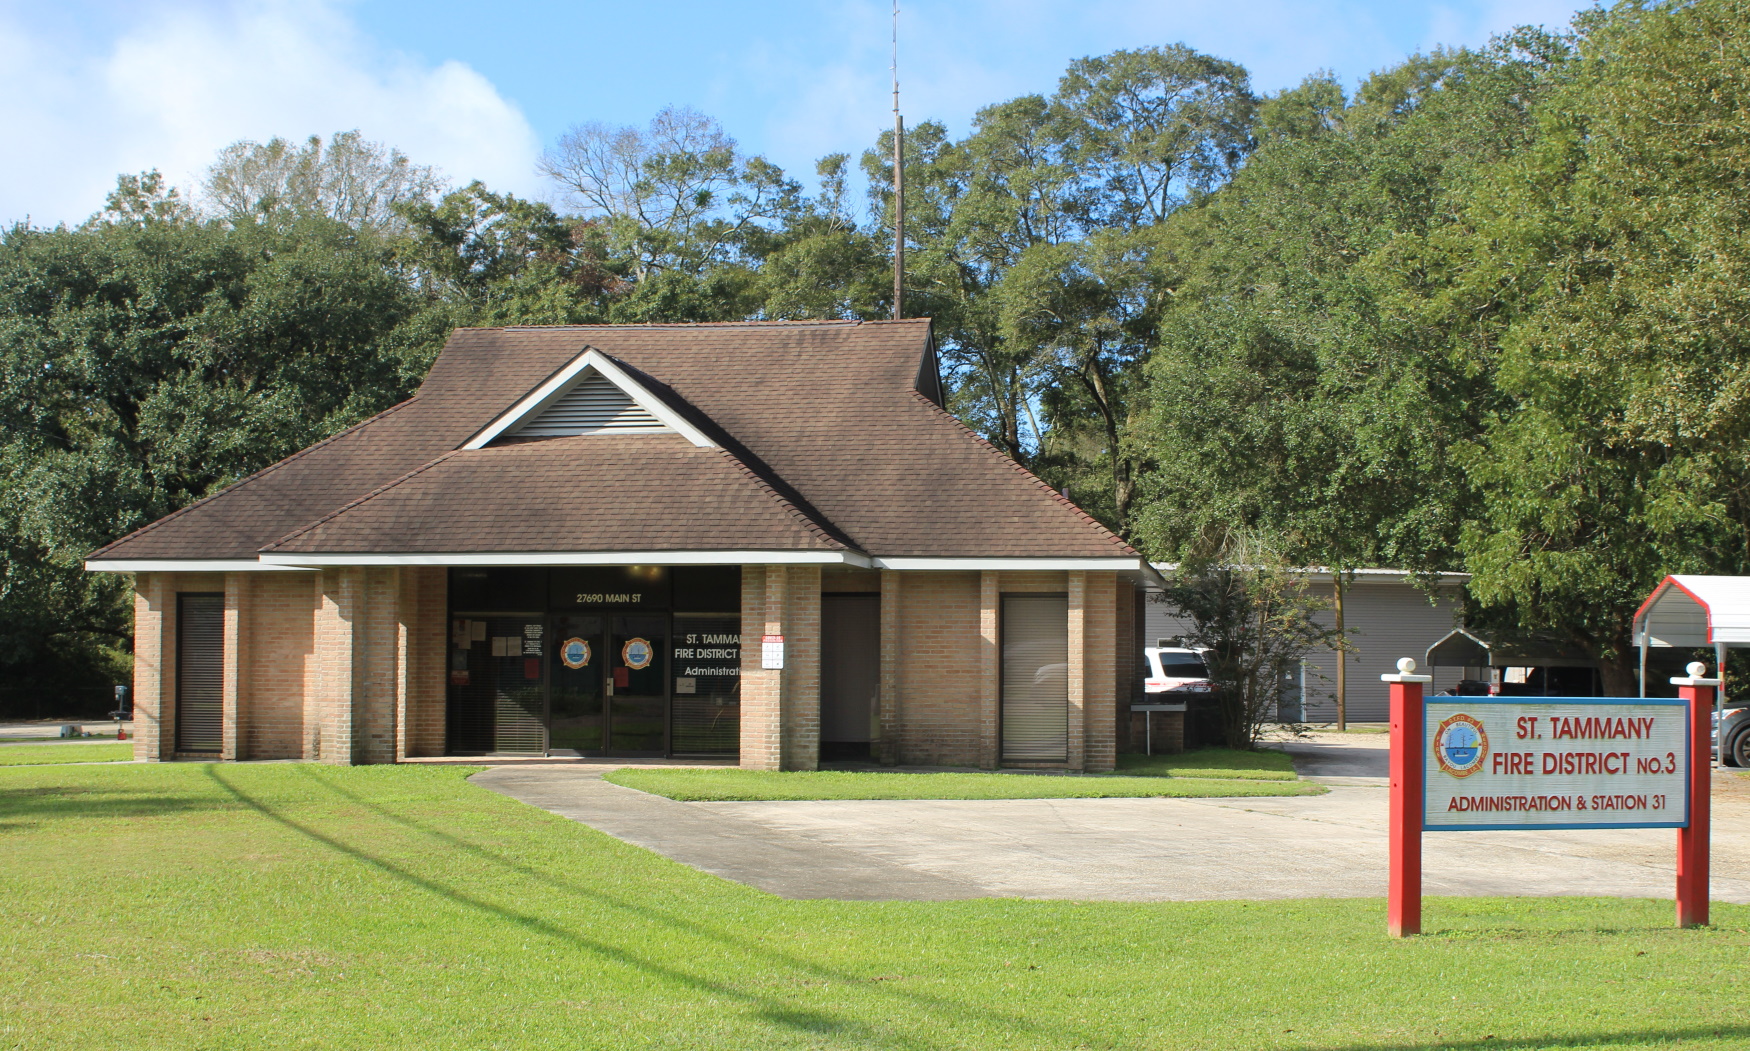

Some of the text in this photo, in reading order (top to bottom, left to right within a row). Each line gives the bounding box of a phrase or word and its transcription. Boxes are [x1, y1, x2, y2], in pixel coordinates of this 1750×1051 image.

[576, 593, 642, 603] 27690 MAIN ST
[686, 633, 699, 644] ST.
[674, 648, 695, 659] FIRE
[696, 648, 738, 659] DISTRICT
[1516, 716, 1655, 740] ST. TAMMANY
[1492, 752, 1534, 775] FIRE
[1542, 752, 1630, 775] DISTRICT
[1448, 794, 1666, 812] ADMINISTRATION & STATION 31
